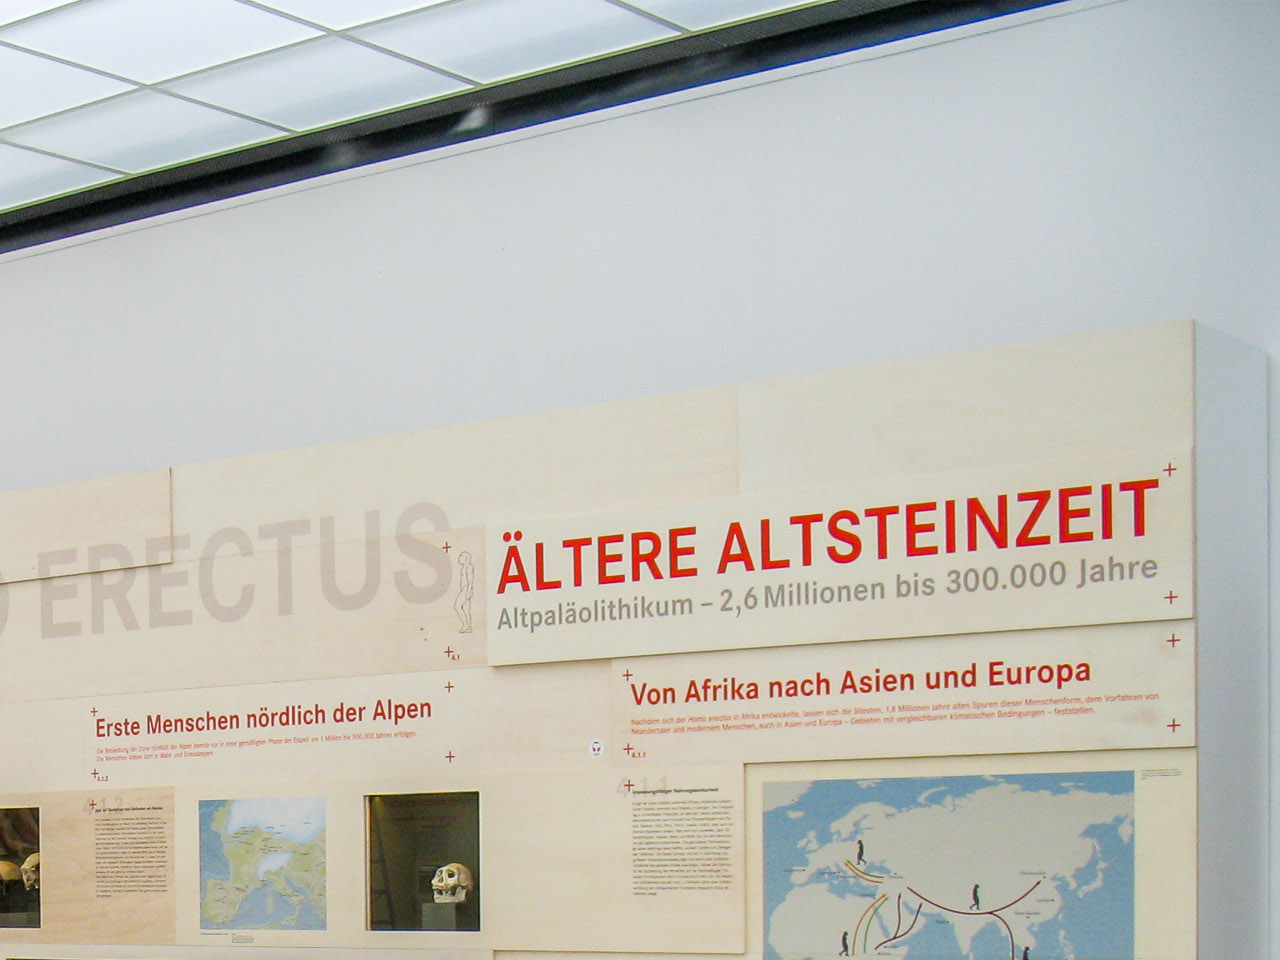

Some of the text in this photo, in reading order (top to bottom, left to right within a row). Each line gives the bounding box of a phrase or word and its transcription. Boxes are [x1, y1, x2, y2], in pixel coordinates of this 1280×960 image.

[37, 503, 453, 640] ERECTUS
[497, 479, 1159, 595] ÄLTERE ALTSTEINZEIT
[497, 597, 694, 633] Altpaläolithikum
[719, 587, 758, 618] 2,6
[764, 580, 885, 609] Millionen
[896, 573, 935, 598] bis
[946, 561, 1067, 594] 300.000
[1076, 556, 1159, 589] Jahre
[96, 698, 432, 738] Erste Menschen nördlich der Alpen
[631, 661, 1091, 706] Von Afrika nach Asien und Europa
